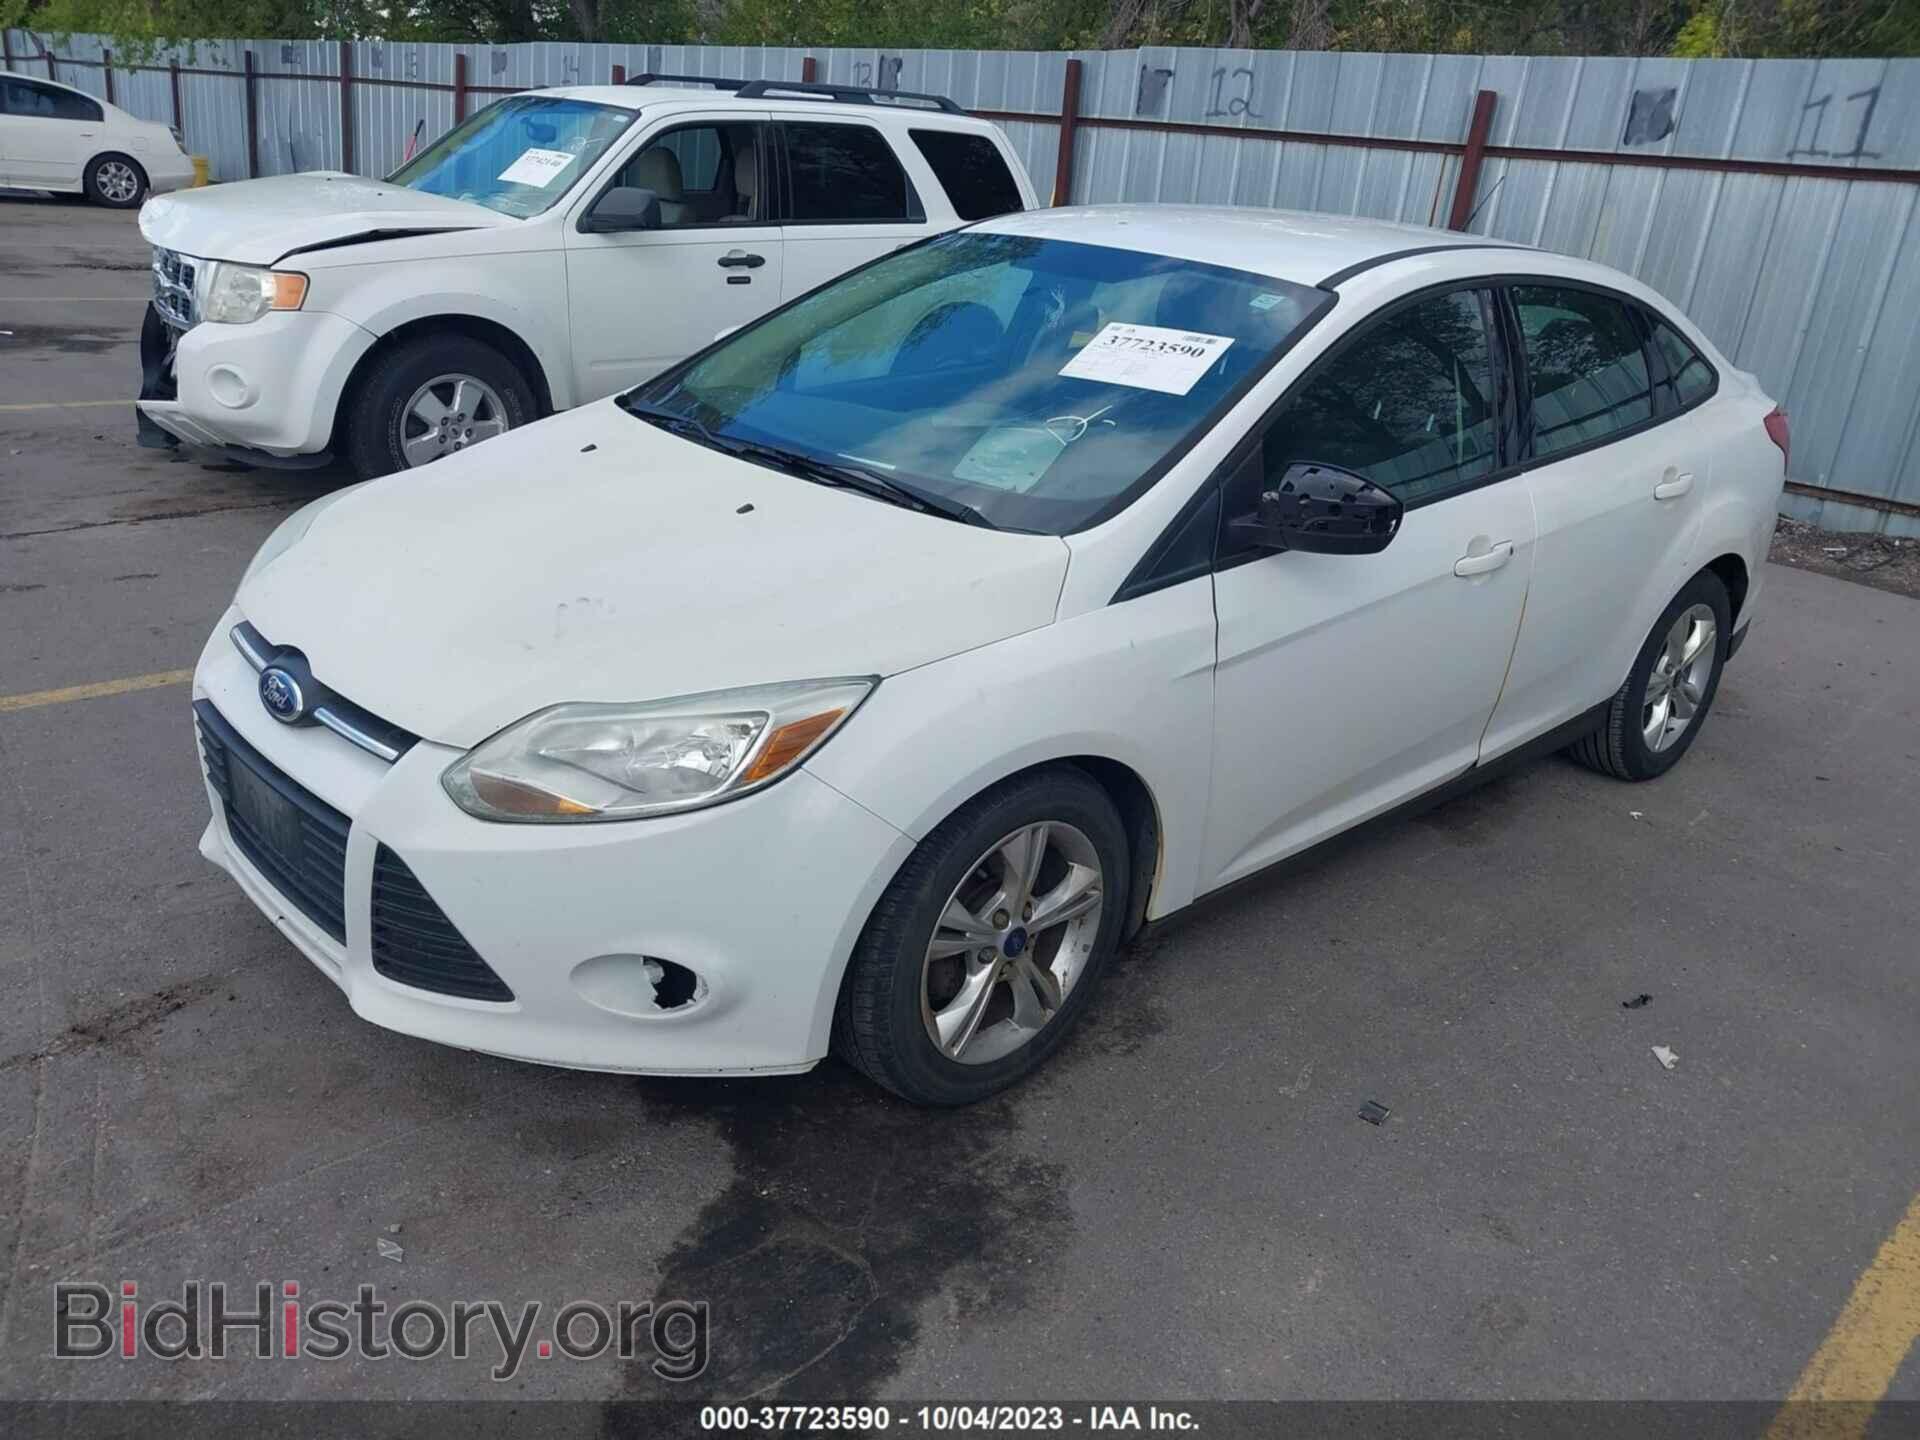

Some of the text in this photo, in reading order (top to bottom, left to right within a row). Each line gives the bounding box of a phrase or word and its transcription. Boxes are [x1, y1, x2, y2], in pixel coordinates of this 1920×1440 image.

[1205, 67, 1265, 118] 12
[1786, 85, 1882, 160] 11
[1103, 334, 1206, 359] 37723590
[262, 675, 289, 710] Ford
